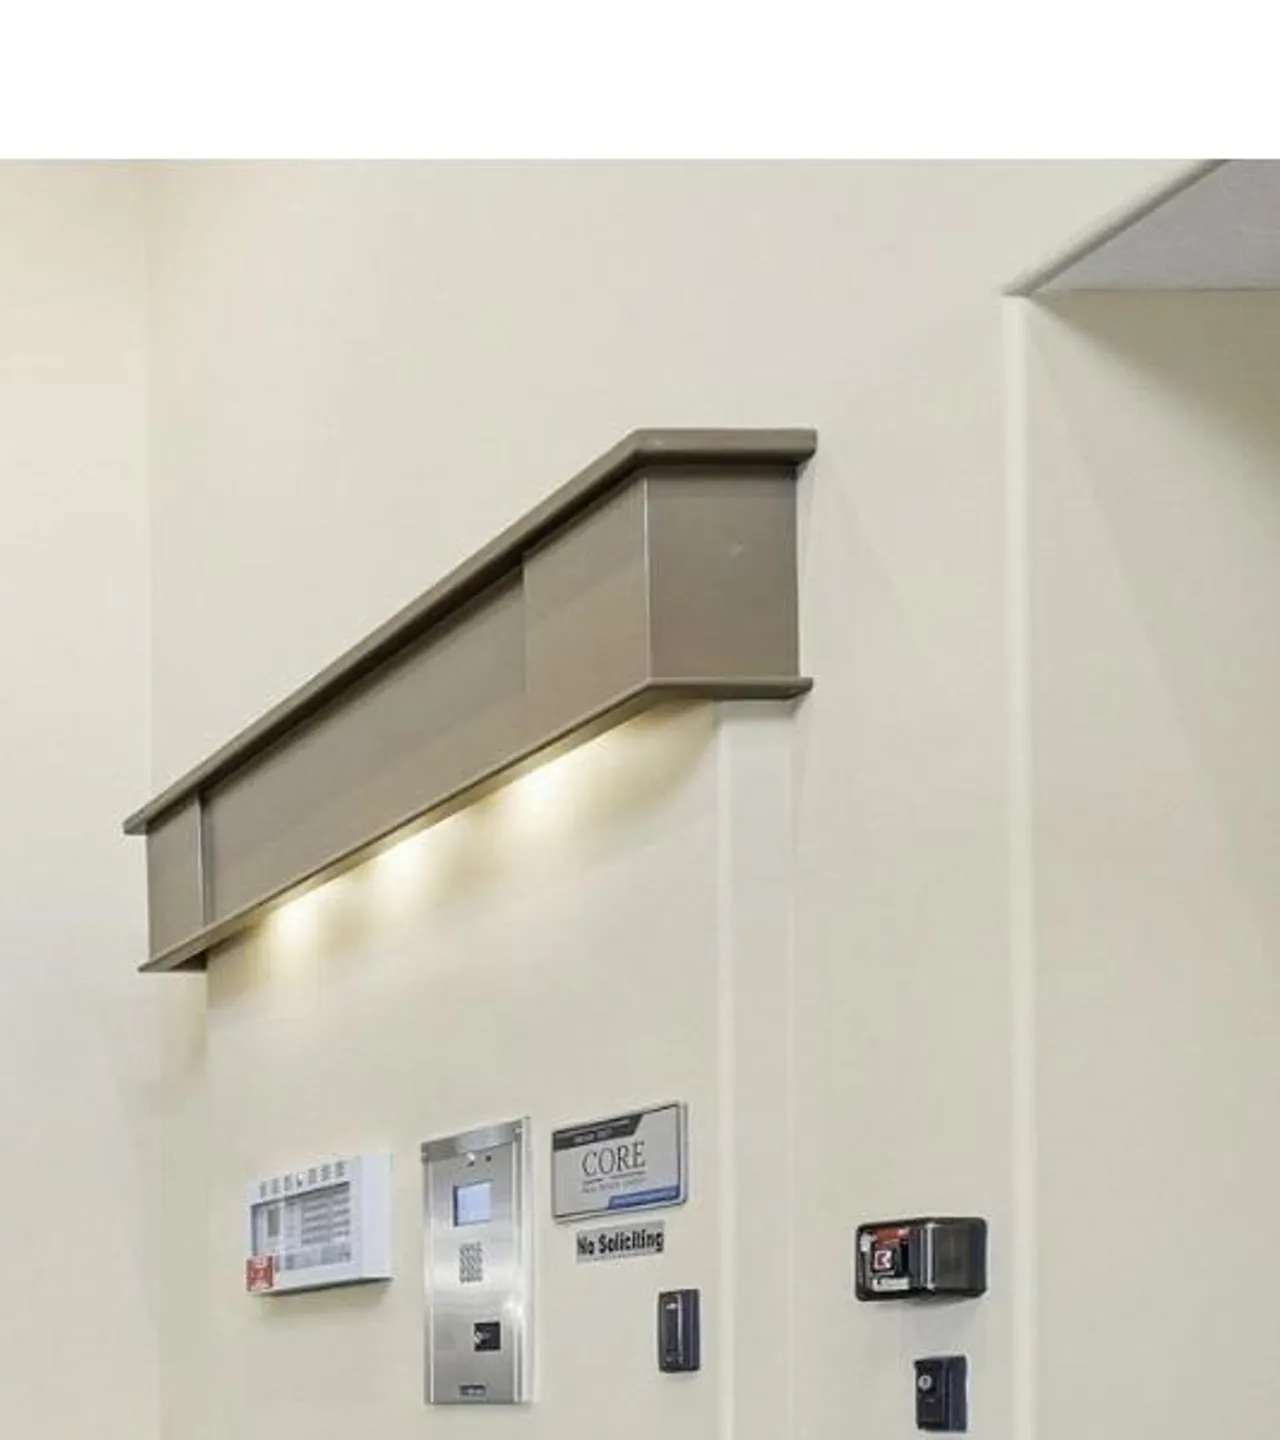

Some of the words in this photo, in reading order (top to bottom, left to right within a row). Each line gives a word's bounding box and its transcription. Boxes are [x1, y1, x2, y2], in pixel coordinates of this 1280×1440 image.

[581, 1140, 647, 1177] CORE
[577, 1236, 595, 1255] No
[598, 1228, 665, 1253] Soliciting
